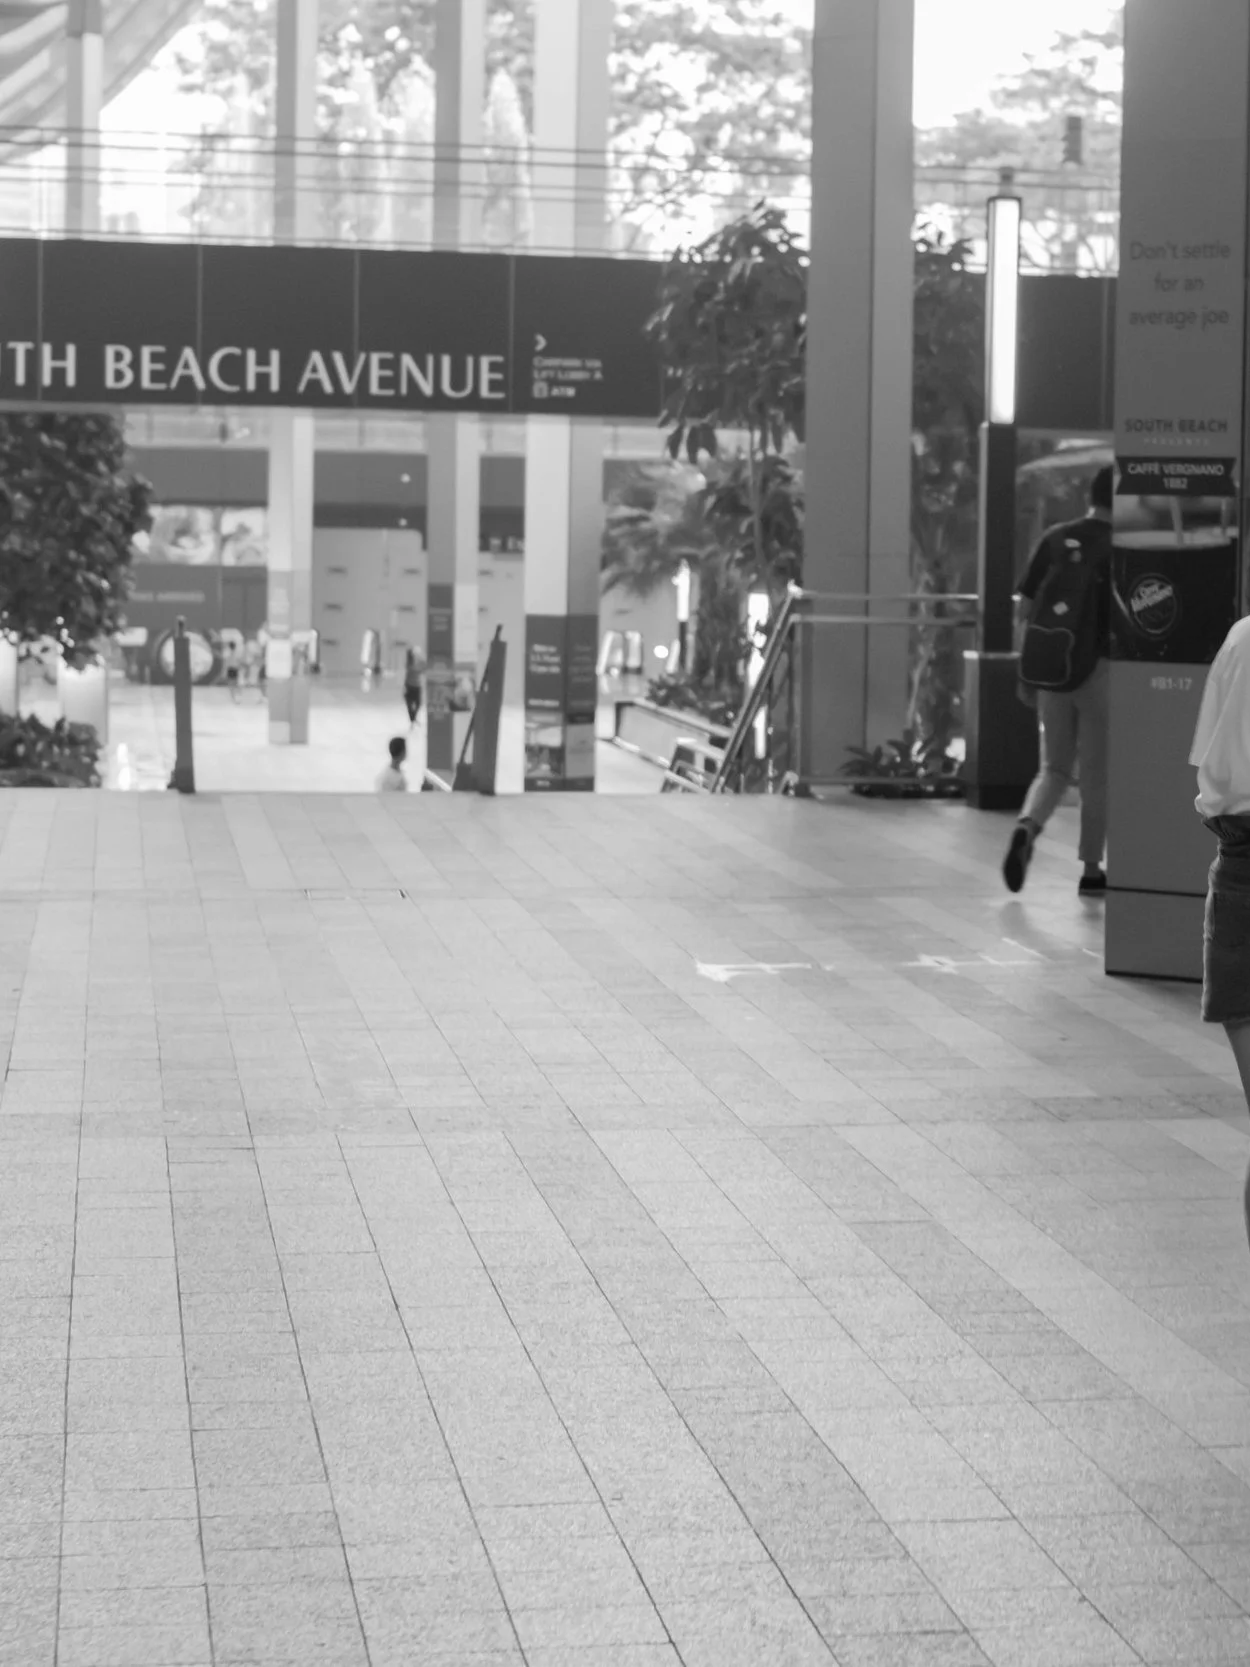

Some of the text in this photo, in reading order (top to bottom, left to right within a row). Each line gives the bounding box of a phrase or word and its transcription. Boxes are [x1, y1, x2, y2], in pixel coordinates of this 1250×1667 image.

[1130, 239, 1231, 260] Don't settle
[1154, 268, 1204, 292] for an
[1130, 305, 1230, 331] average joe
[0, 341, 505, 399] TH BEACH AVENUE
[1125, 418, 1228, 433] SOUTH BEACH
[1162, 463, 1225, 476] VERGNANO
